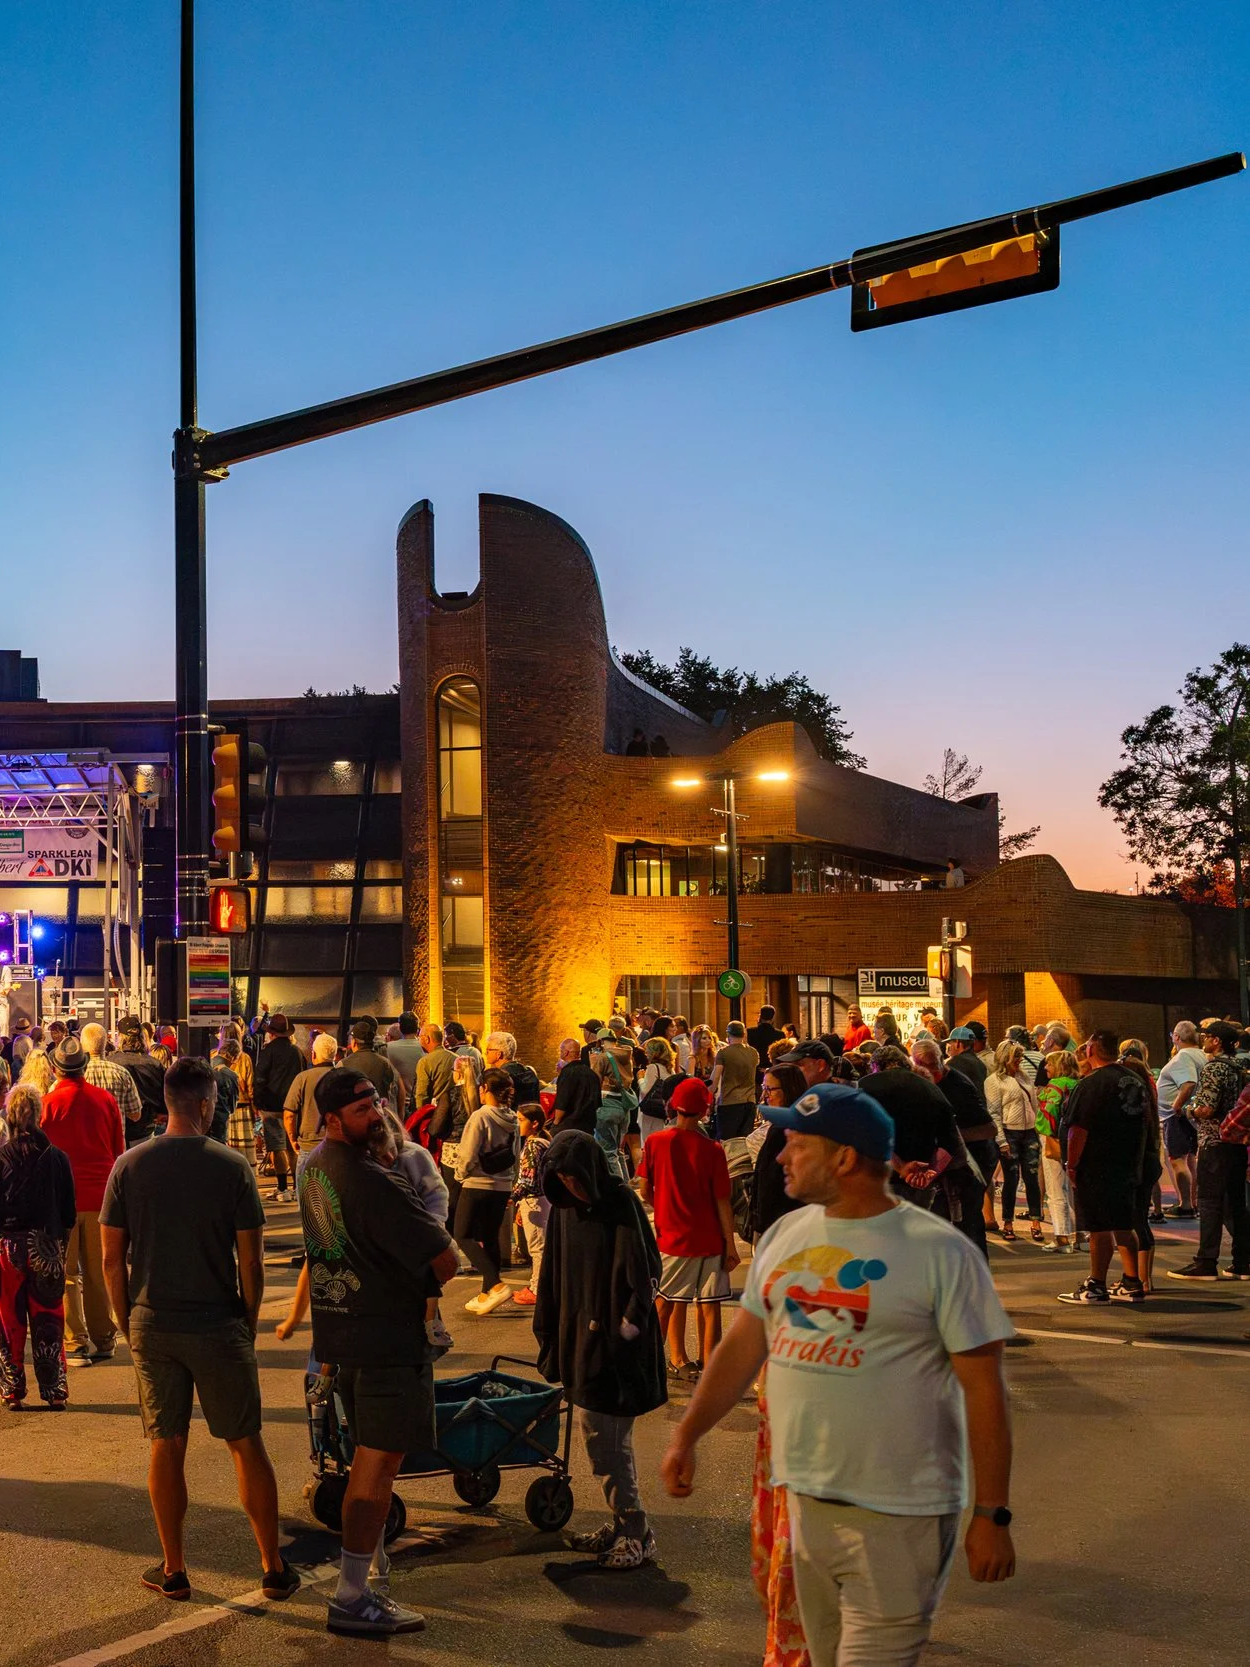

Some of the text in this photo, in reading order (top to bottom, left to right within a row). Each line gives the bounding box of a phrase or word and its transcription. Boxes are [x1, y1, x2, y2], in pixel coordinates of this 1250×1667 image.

[27, 850, 92, 859] SPARKLEAN
[54, 859, 92, 877] DKI
[880, 975, 929, 986] museu
[861, 1000, 884, 1009] musée
